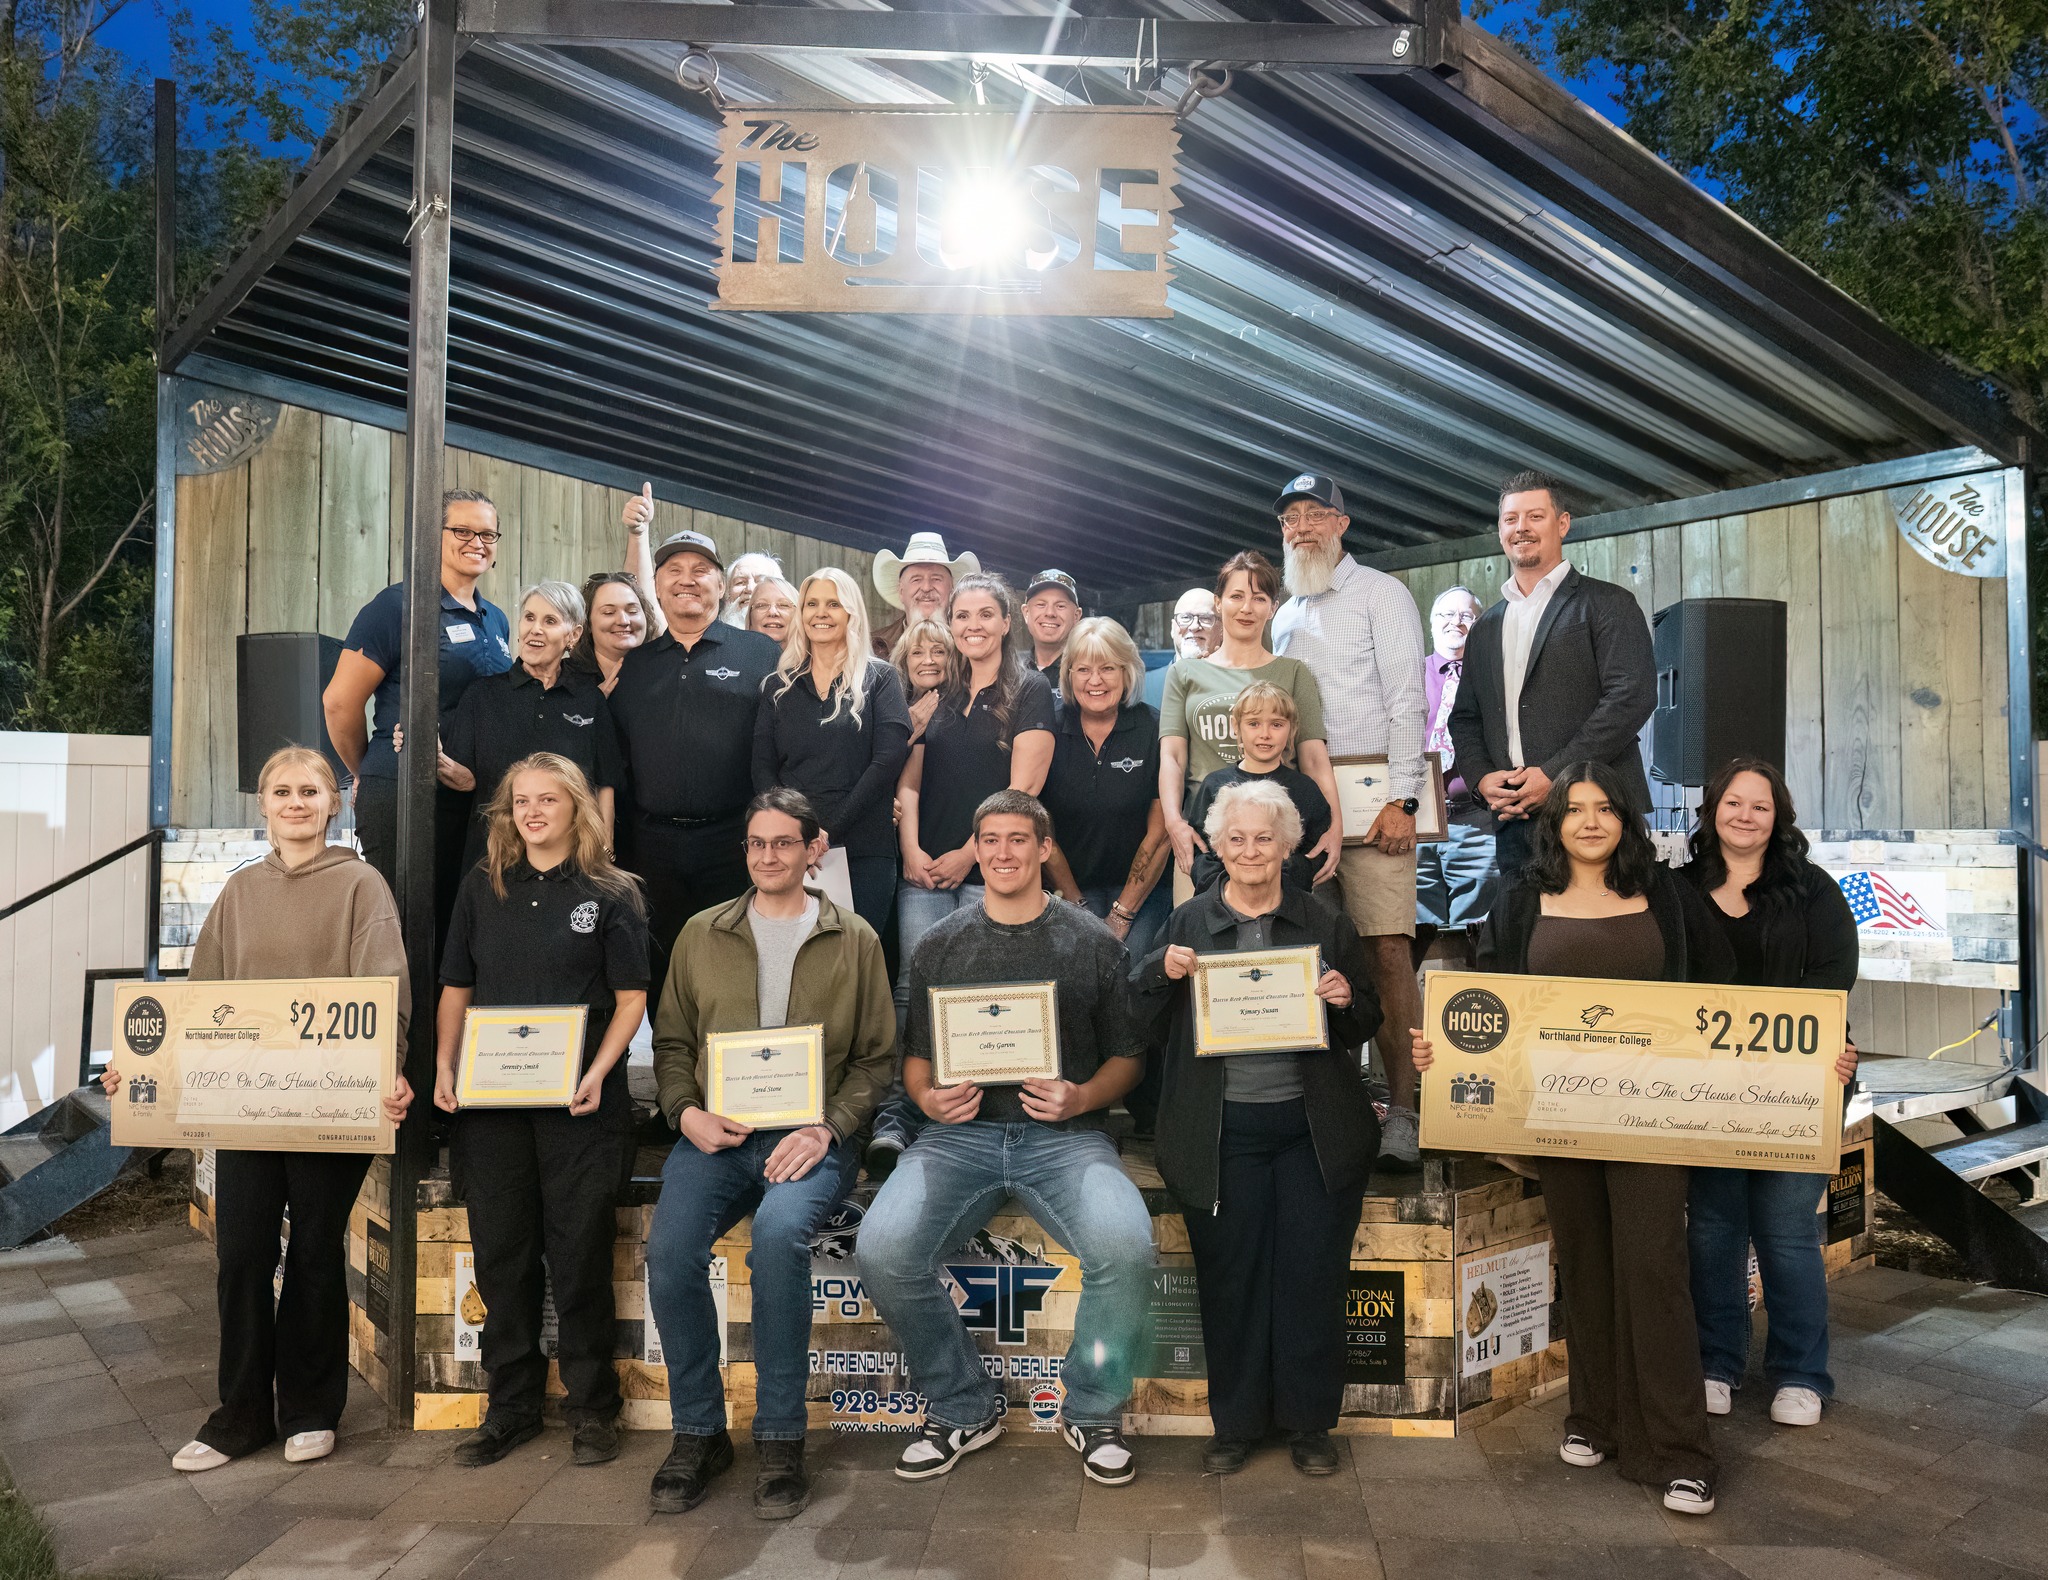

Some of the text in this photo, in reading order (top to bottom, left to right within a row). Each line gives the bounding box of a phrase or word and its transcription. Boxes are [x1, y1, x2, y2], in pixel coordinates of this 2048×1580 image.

[736, 119, 821, 152] The
[731, 161, 1160, 272] HOUSE
[1949, 483, 1985, 517] The
[1899, 487, 1998, 570] HOUSE
[1198, 713, 1238, 741] HOU
[1261, 1007, 1279, 1015] Susan
[1470, 1002, 1482, 1010] The
[127, 1017, 163, 1037] HOUSE
[290, 998, 378, 1046] $2,200
[1448, 1010, 1503, 1034] HOUSE
[185, 1031, 260, 1042] Northland Pioneer College
[1539, 1030, 1652, 1047] Northland Pioneer College
[1695, 1005, 1820, 1057] $2,200
[979, 1042, 996, 1050] Colby
[500, 1062, 540, 1071] Serenity Smith
[185, 1071, 378, 1093] NPC On The House Scholarship
[752, 1086, 767, 1094] Jared
[1541, 1074, 1820, 1111] NPC On The House Scholarship
[1463, 1113, 1488, 1121] Family
[1468, 1105, 1494, 1113] Friends
[1659, 1116, 1709, 1131] Sandoval
[1721, 1119, 1754, 1134] Show
[1756, 1121, 1780, 1138] Low
[1781, 1123, 1818, 1138] HS
[317, 1134, 376, 1142] CONGRATULATIONS
[1536, 1137, 1578, 1146] 042326-2
[1735, 1149, 1817, 1161] CONGRATULATIONS
[1830, 1171, 1863, 1194] BULLION
[368, 1246, 390, 1275] BULLIO
[1467, 1257, 1508, 1280] HELMUT
[1171, 1276, 1197, 1285] VIBR
[1171, 1286, 1200, 1295] Medsp
[1347, 1289, 1395, 1301] TIONAL
[1502, 1288, 1516, 1297] ROLEX
[1346, 1300, 1395, 1318] LION
[1359, 1318, 1380, 1327] LOW
[1356, 1333, 1387, 1343] GOLD
[825, 1352, 897, 1374] FRIENDLY
[978, 1355, 1004, 1378] RD
[1029, 1384, 1061, 1395] NACKARD
